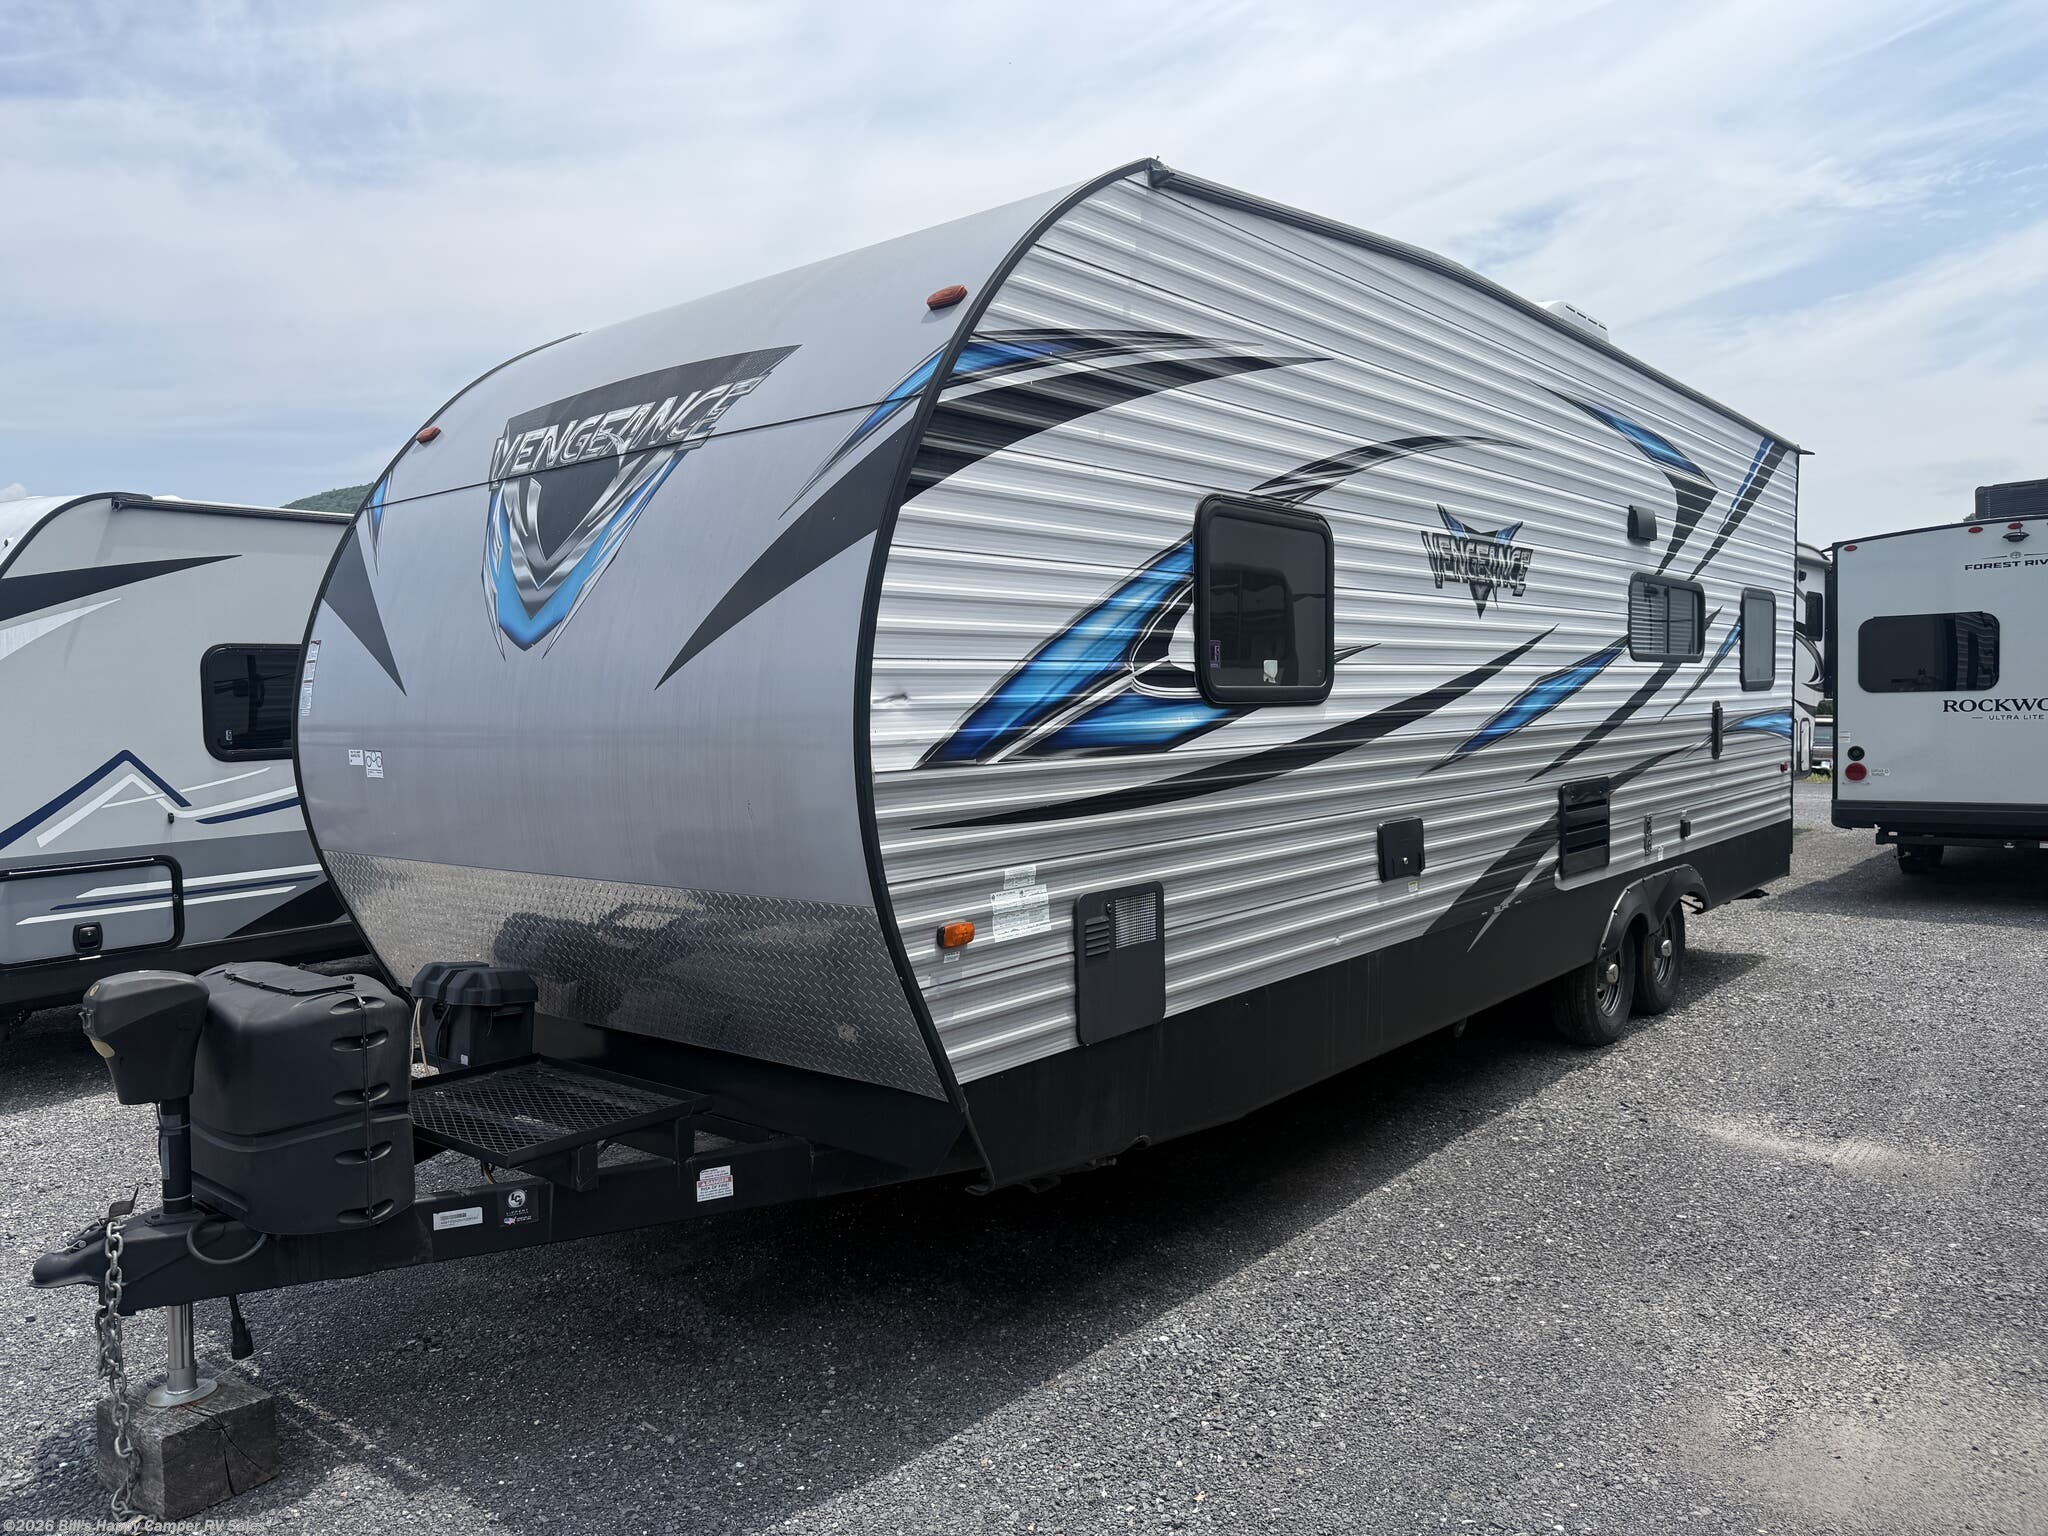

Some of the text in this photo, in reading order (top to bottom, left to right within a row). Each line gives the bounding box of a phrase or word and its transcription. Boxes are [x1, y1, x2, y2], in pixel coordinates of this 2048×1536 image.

[488, 371, 773, 492] VENGEANCE
[1420, 530, 1534, 597] VENGEANCE
[1964, 561, 2021, 571] FOREST
